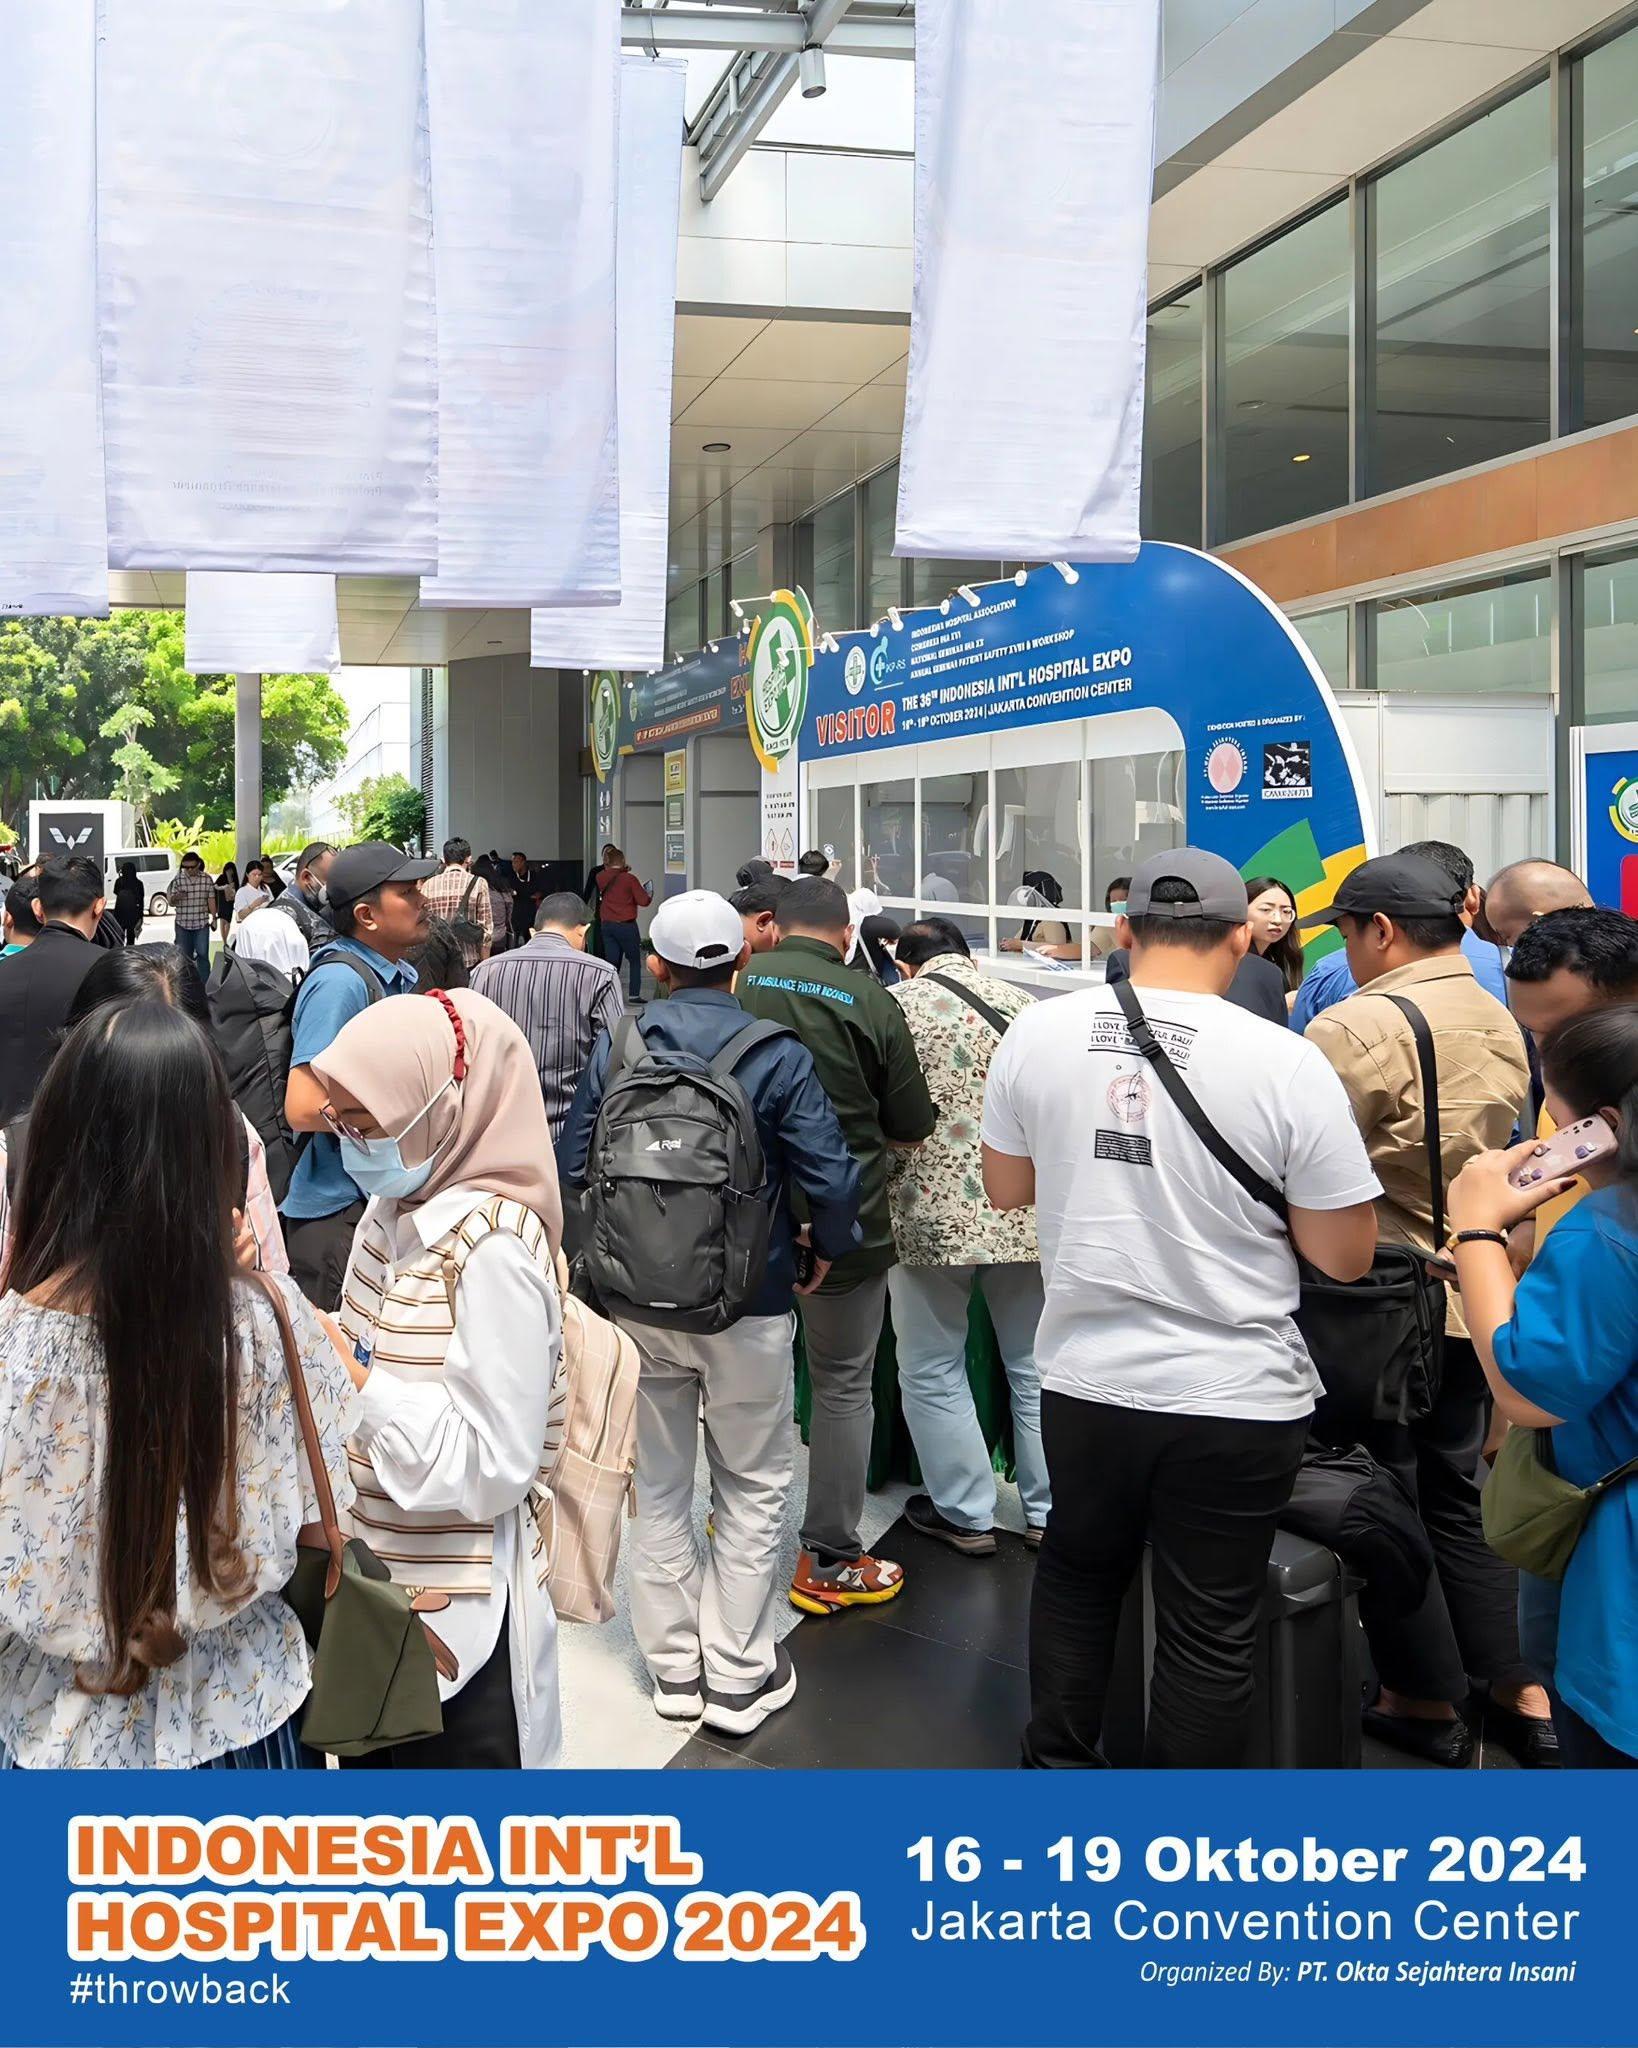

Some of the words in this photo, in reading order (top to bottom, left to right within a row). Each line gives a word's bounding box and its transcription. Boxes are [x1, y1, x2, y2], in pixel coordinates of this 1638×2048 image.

[902, 694, 918, 711] THE
[939, 677, 995, 705] INDONESIA
[998, 670, 1026, 692] INT'L
[1028, 656, 1090, 686] HOSPITAL
[1092, 646, 1132, 673] EXPO
[930, 709, 964, 725] OCTOBER
[987, 697, 1026, 717] JAKARTA
[1026, 685, 1089, 709] CONVENTION
[1090, 677, 1132, 698] CENTER
[815, 699, 896, 747] VISITOR
[747, 975, 756, 986] PT
[756, 976, 797, 992] AMBULANCE
[1096, 1035, 1117, 1043] LOVE
[1098, 1022, 1120, 1030] LOVE
